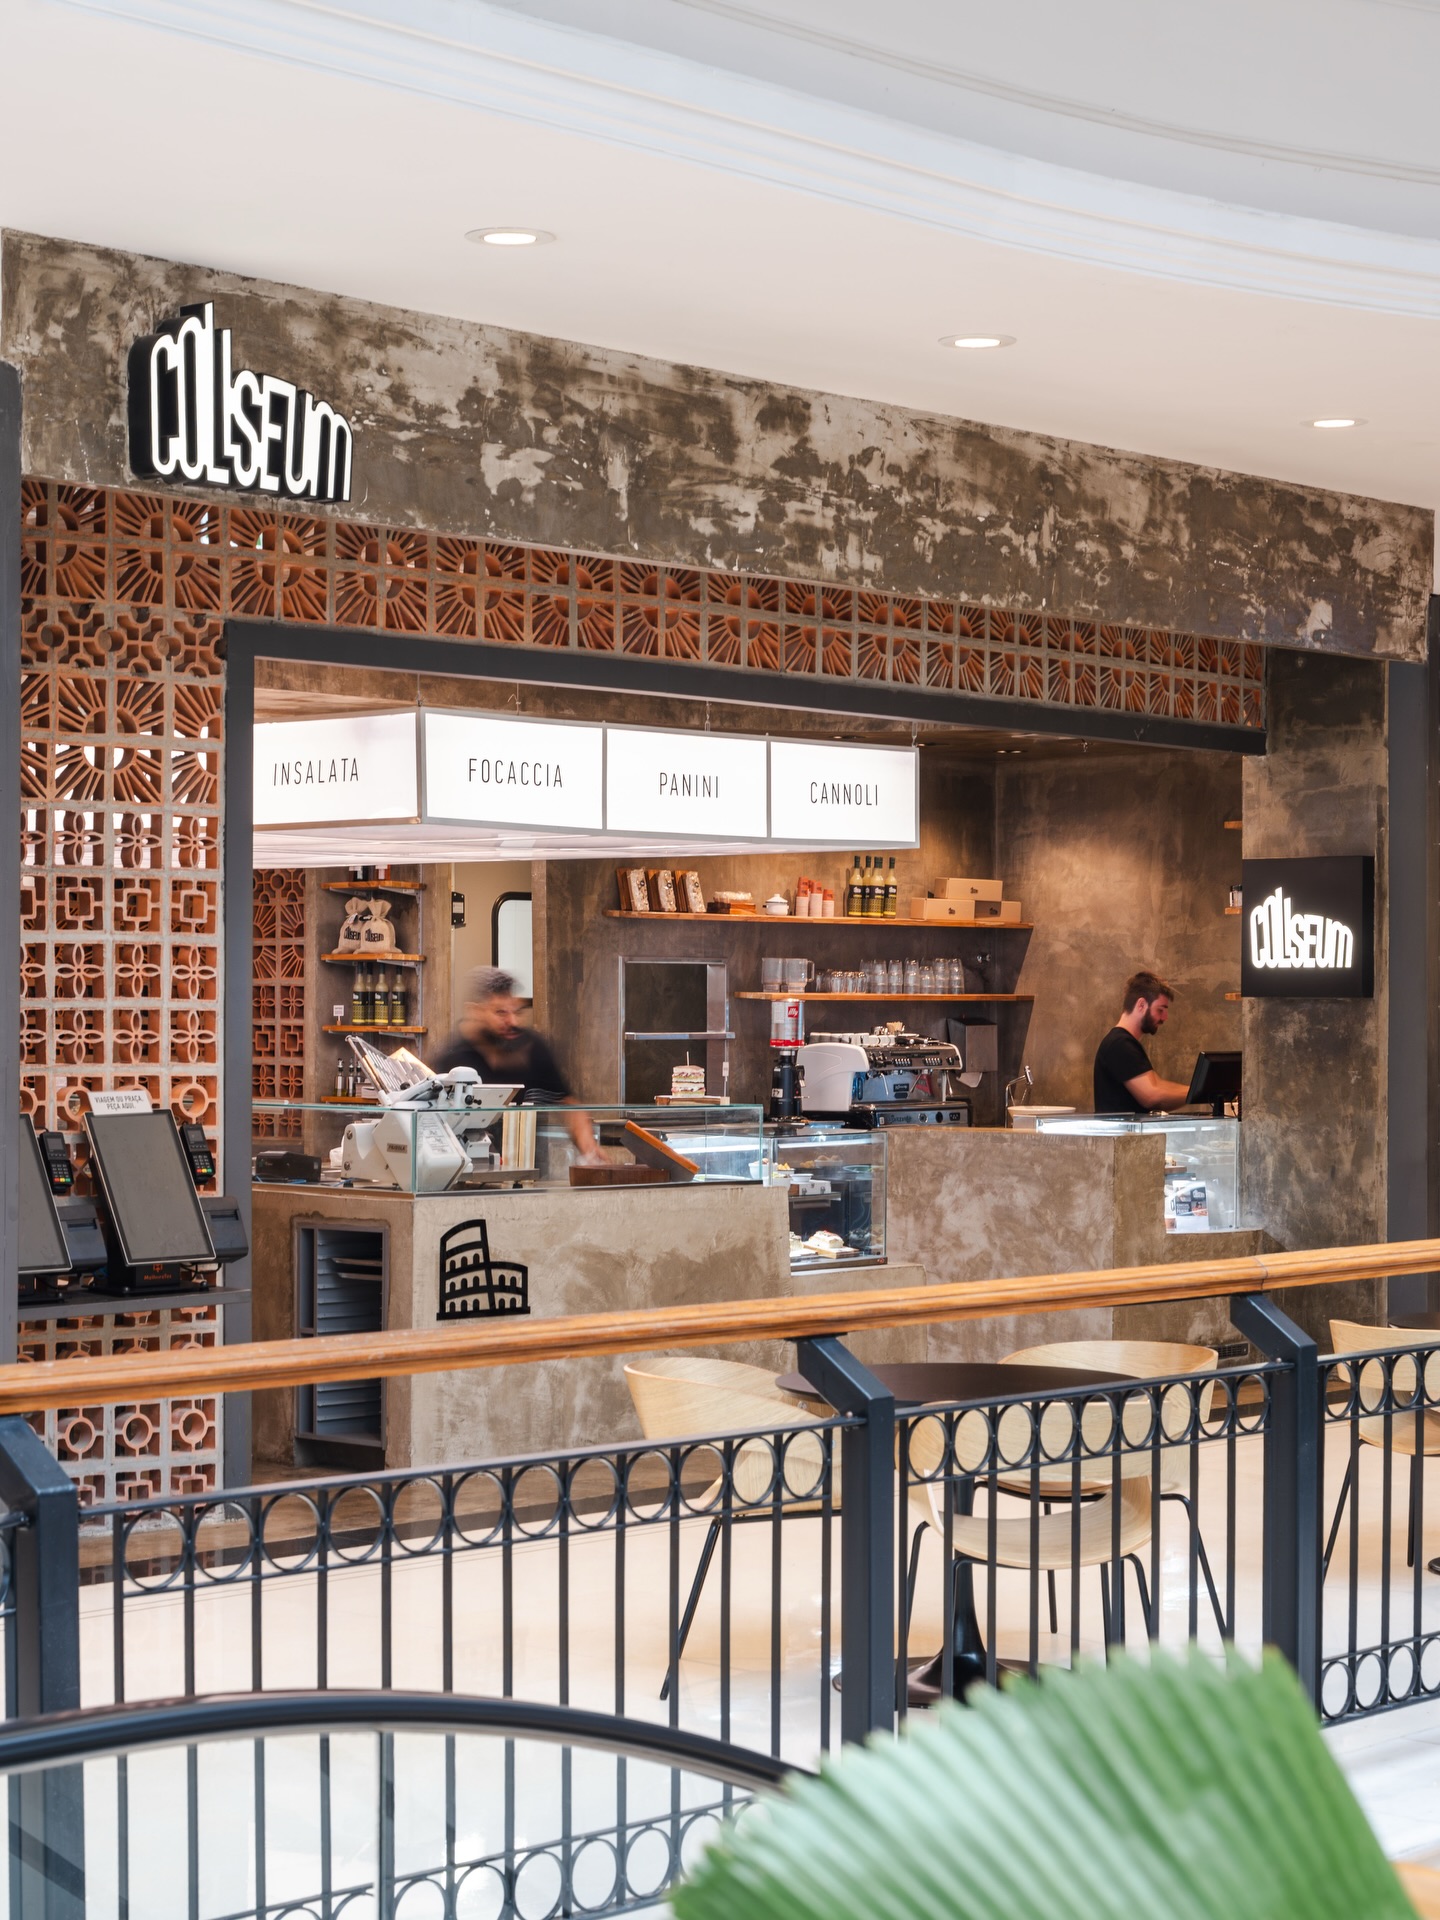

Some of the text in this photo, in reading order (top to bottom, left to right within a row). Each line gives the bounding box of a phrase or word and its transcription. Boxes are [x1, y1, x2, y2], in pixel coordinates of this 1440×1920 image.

[273, 757, 359, 786] INSALATA
[468, 757, 563, 788] FOCACCIA
[659, 772, 719, 799] PANINI
[810, 781, 879, 806] CANNOLI
[94, 1096, 115, 1104] VIAGEM
[107, 1104, 121, 1112] PEÇA
